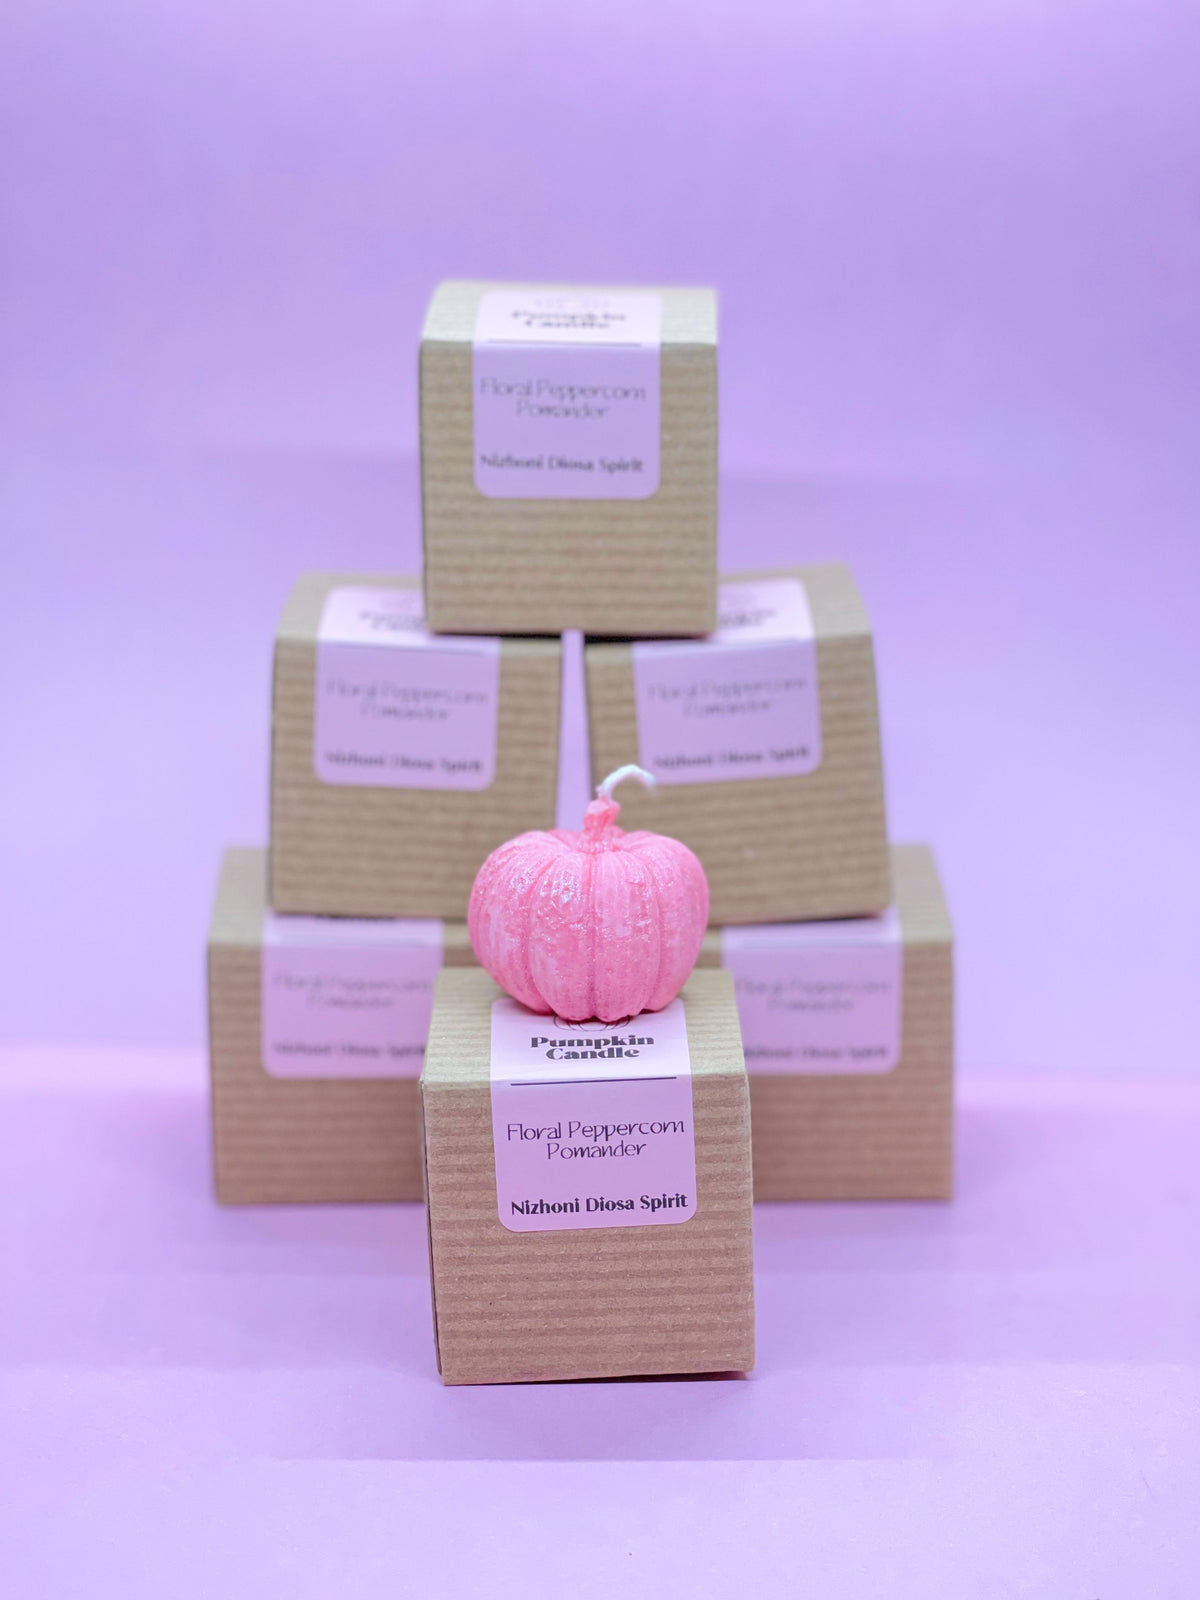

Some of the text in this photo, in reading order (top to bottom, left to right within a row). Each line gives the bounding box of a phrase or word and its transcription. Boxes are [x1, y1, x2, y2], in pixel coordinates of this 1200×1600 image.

[530, 1034, 655, 1050] Pumpkin
[545, 1047, 640, 1061] Candle
[507, 1120, 685, 1142] Floral Peppercorn
[547, 1140, 647, 1160] Pomander
[511, 1193, 688, 1215] Nizhoni Diosa Spirit
